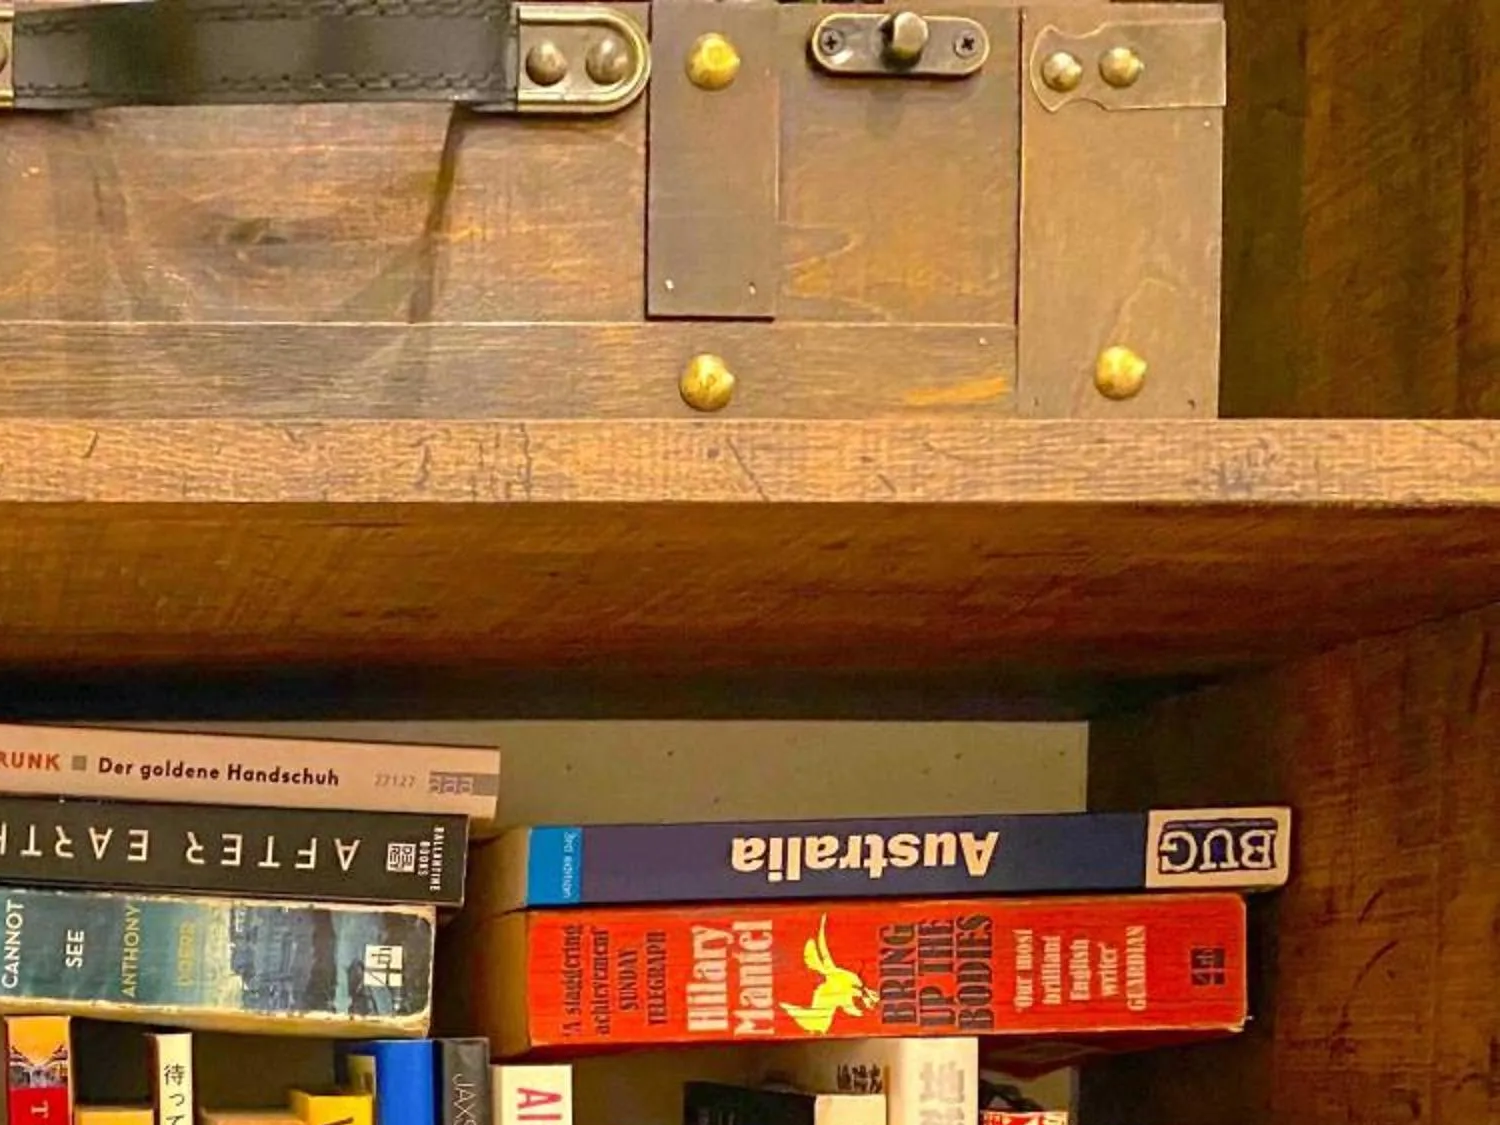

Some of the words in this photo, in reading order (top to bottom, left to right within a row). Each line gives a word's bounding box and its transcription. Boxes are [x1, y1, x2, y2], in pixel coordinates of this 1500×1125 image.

[99, 757, 134, 776] Der
[139, 761, 220, 780] goldene
[227, 763, 339, 787] Handschuh
[185, 831, 361, 872] AFTER
[416, 840, 430, 877] BOOKS
[731, 830, 999, 883] Australia
[1158, 827, 1275, 874] BUG
[1, 899, 25, 989] CANNOT
[65, 929, 86, 969] SEE
[120, 904, 143, 999] ANTHONY
[878, 921, 918, 1027] BRING
[917, 918, 956, 977] THE
[955, 913, 995, 1031] BODIES
[1041, 935, 1062, 1005] brilliant
[1068, 937, 1091, 1001] English
[1125, 925, 1147, 1012] GUARDIAN
[617, 948, 639, 1013] SUNDAY
[645, 931, 668, 1026] TELEGRAPH
[686, 925, 735, 1032] Hilary
[732, 919, 775, 1037] Mantel
[917, 985, 957, 1029] UP
